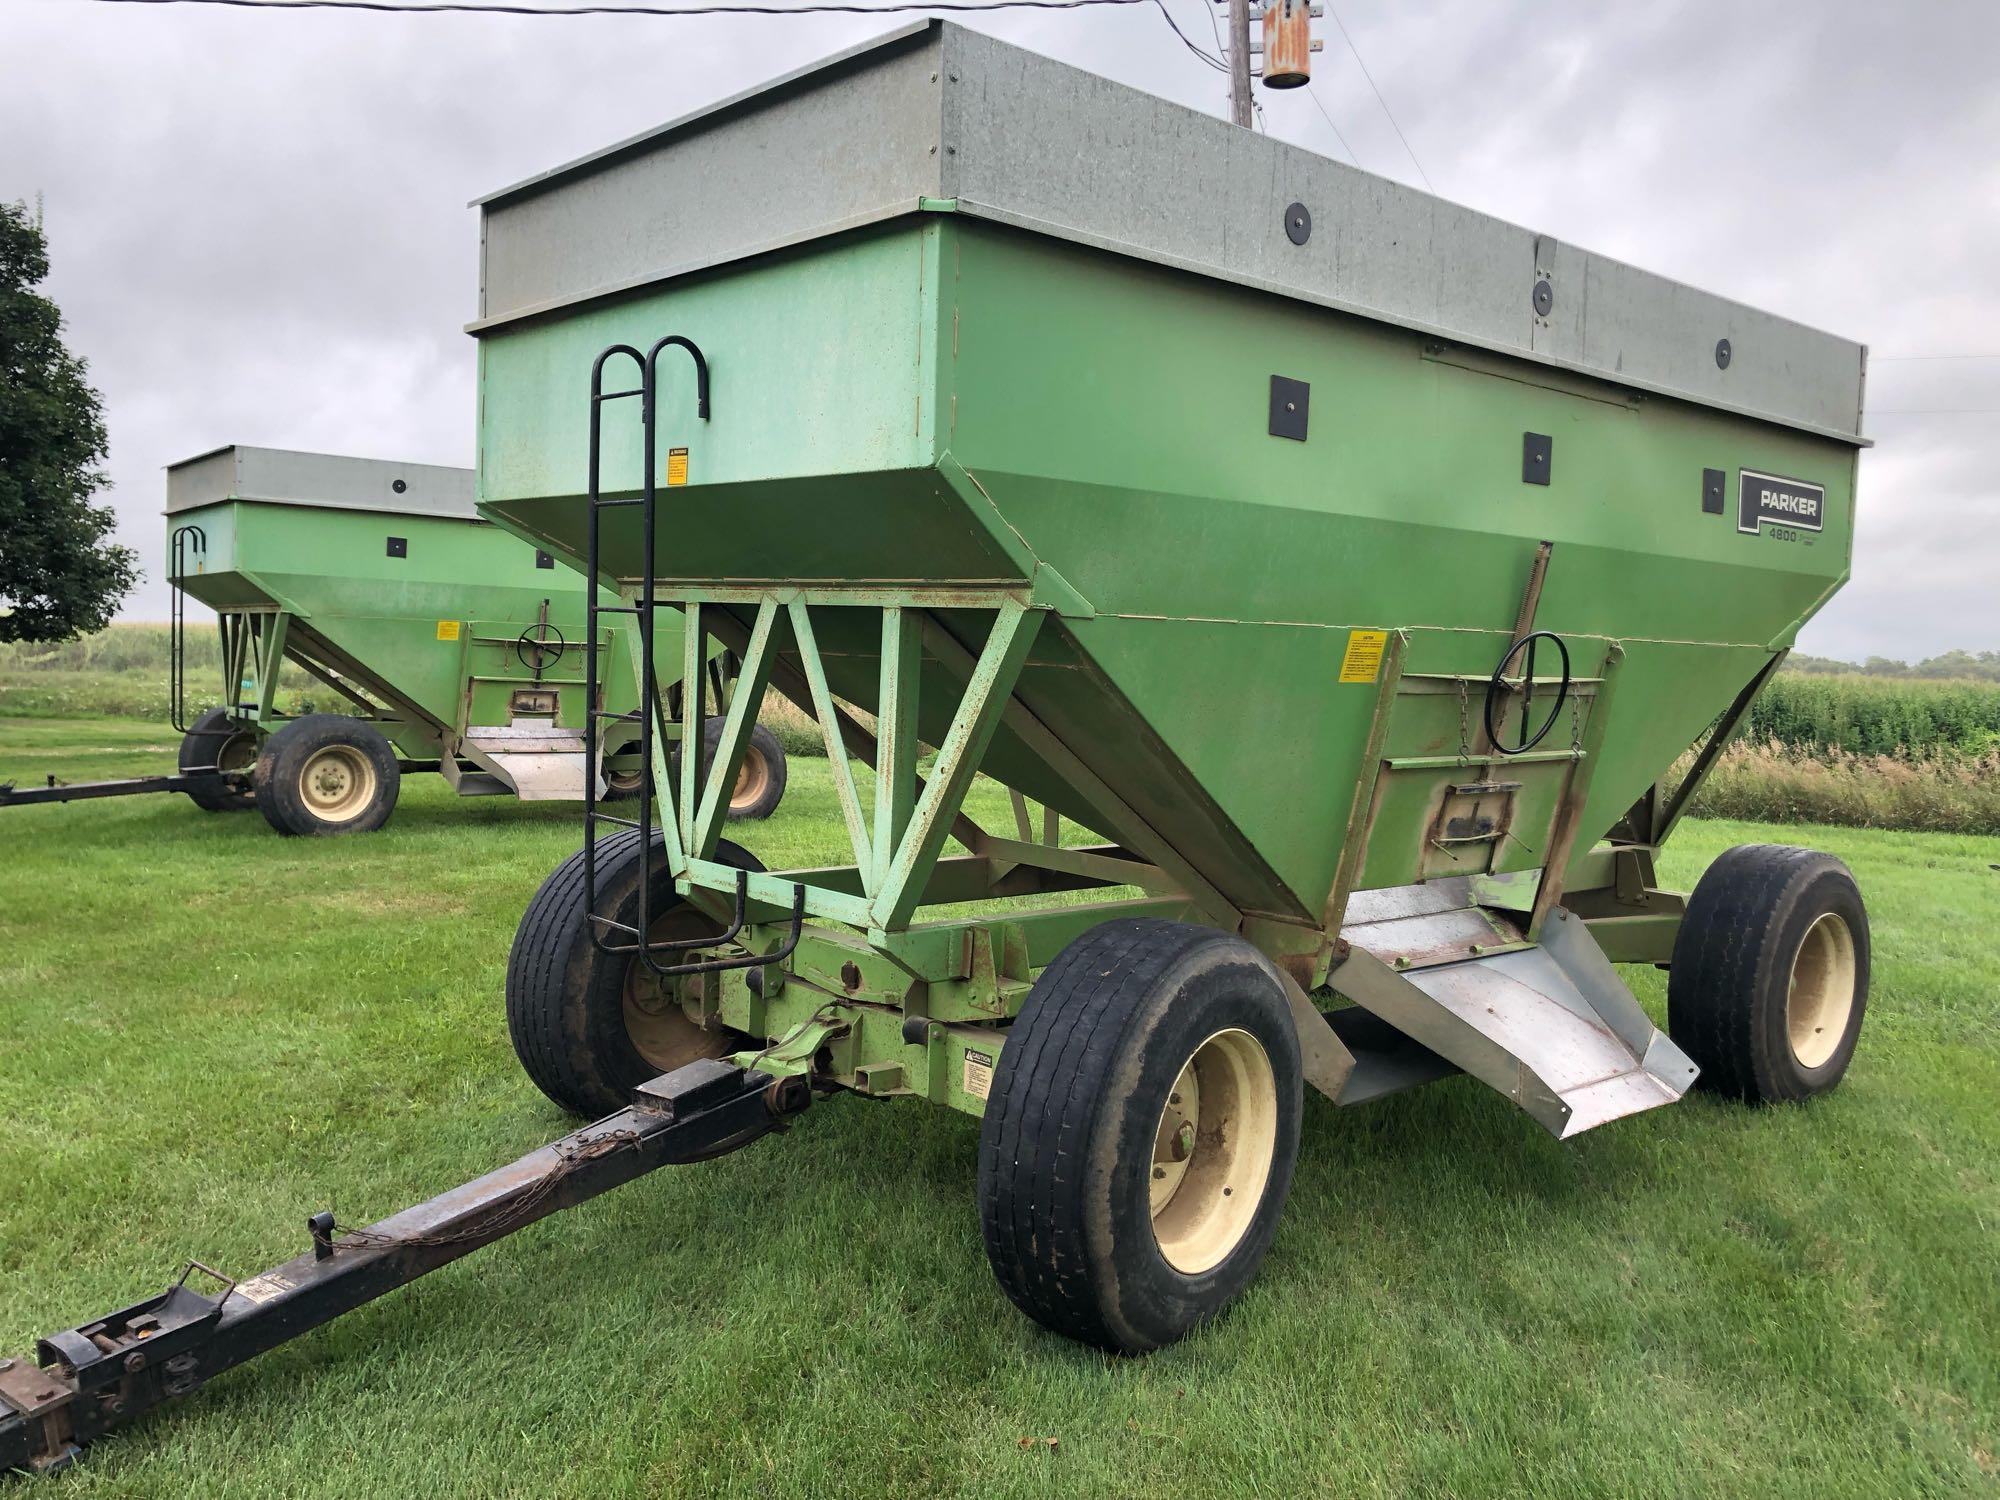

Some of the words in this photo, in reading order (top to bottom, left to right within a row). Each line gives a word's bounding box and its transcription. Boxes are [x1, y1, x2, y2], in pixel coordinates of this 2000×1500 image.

[1760, 490, 1817, 516] PARKER
[1769, 528, 1797, 543] 4800
[971, 1052, 991, 1063] CAUTION
